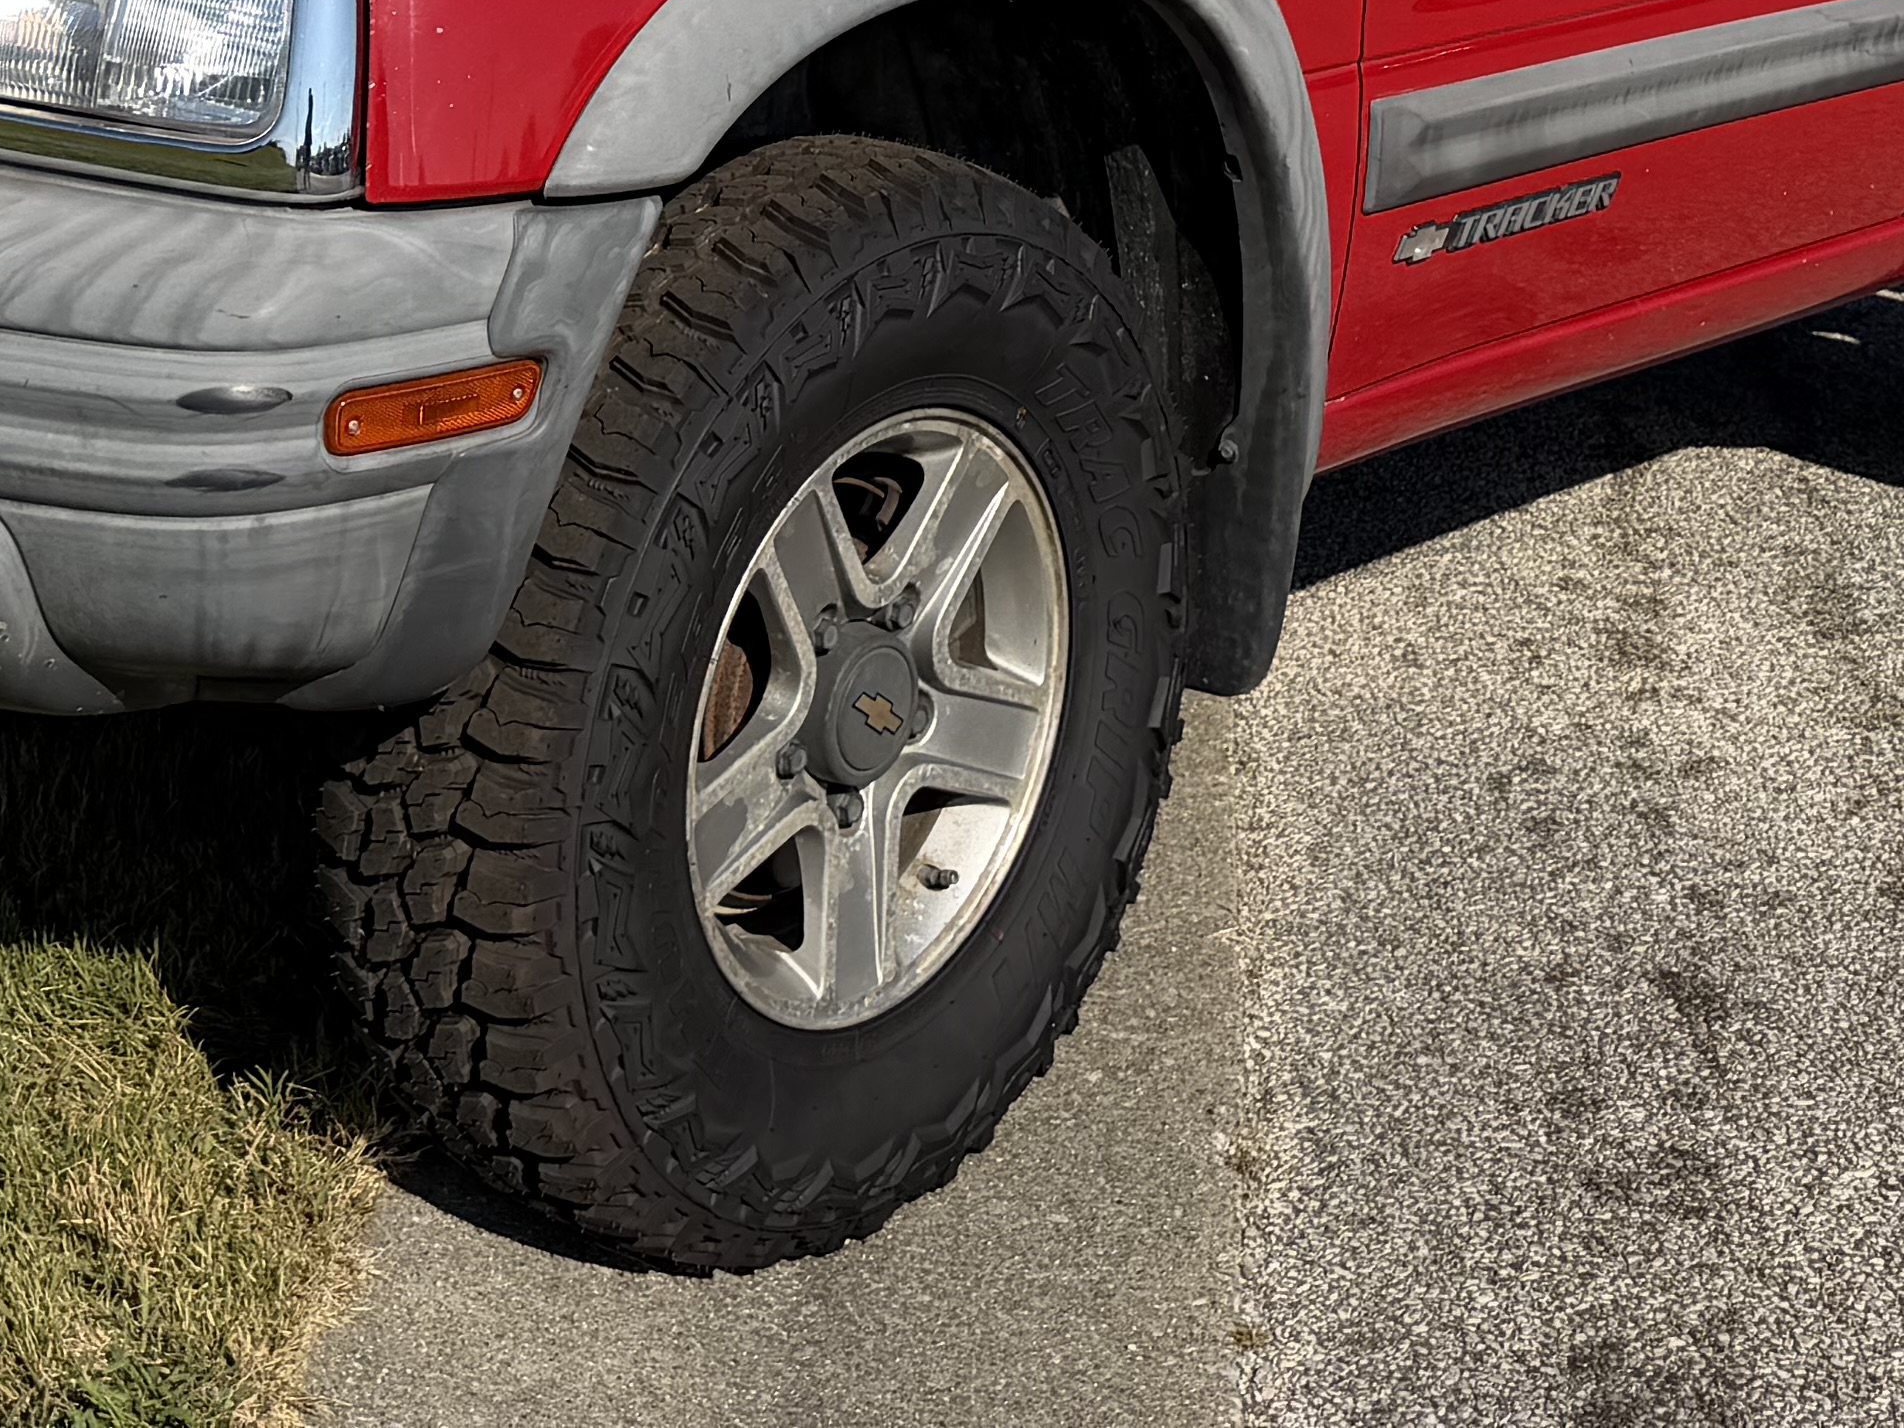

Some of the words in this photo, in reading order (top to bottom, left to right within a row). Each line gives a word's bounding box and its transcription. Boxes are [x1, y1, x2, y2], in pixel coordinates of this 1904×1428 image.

[1449, 173, 1622, 251] TRACKER
[1031, 358, 1146, 564] TRAC
[1084, 588, 1148, 843] GRIP
